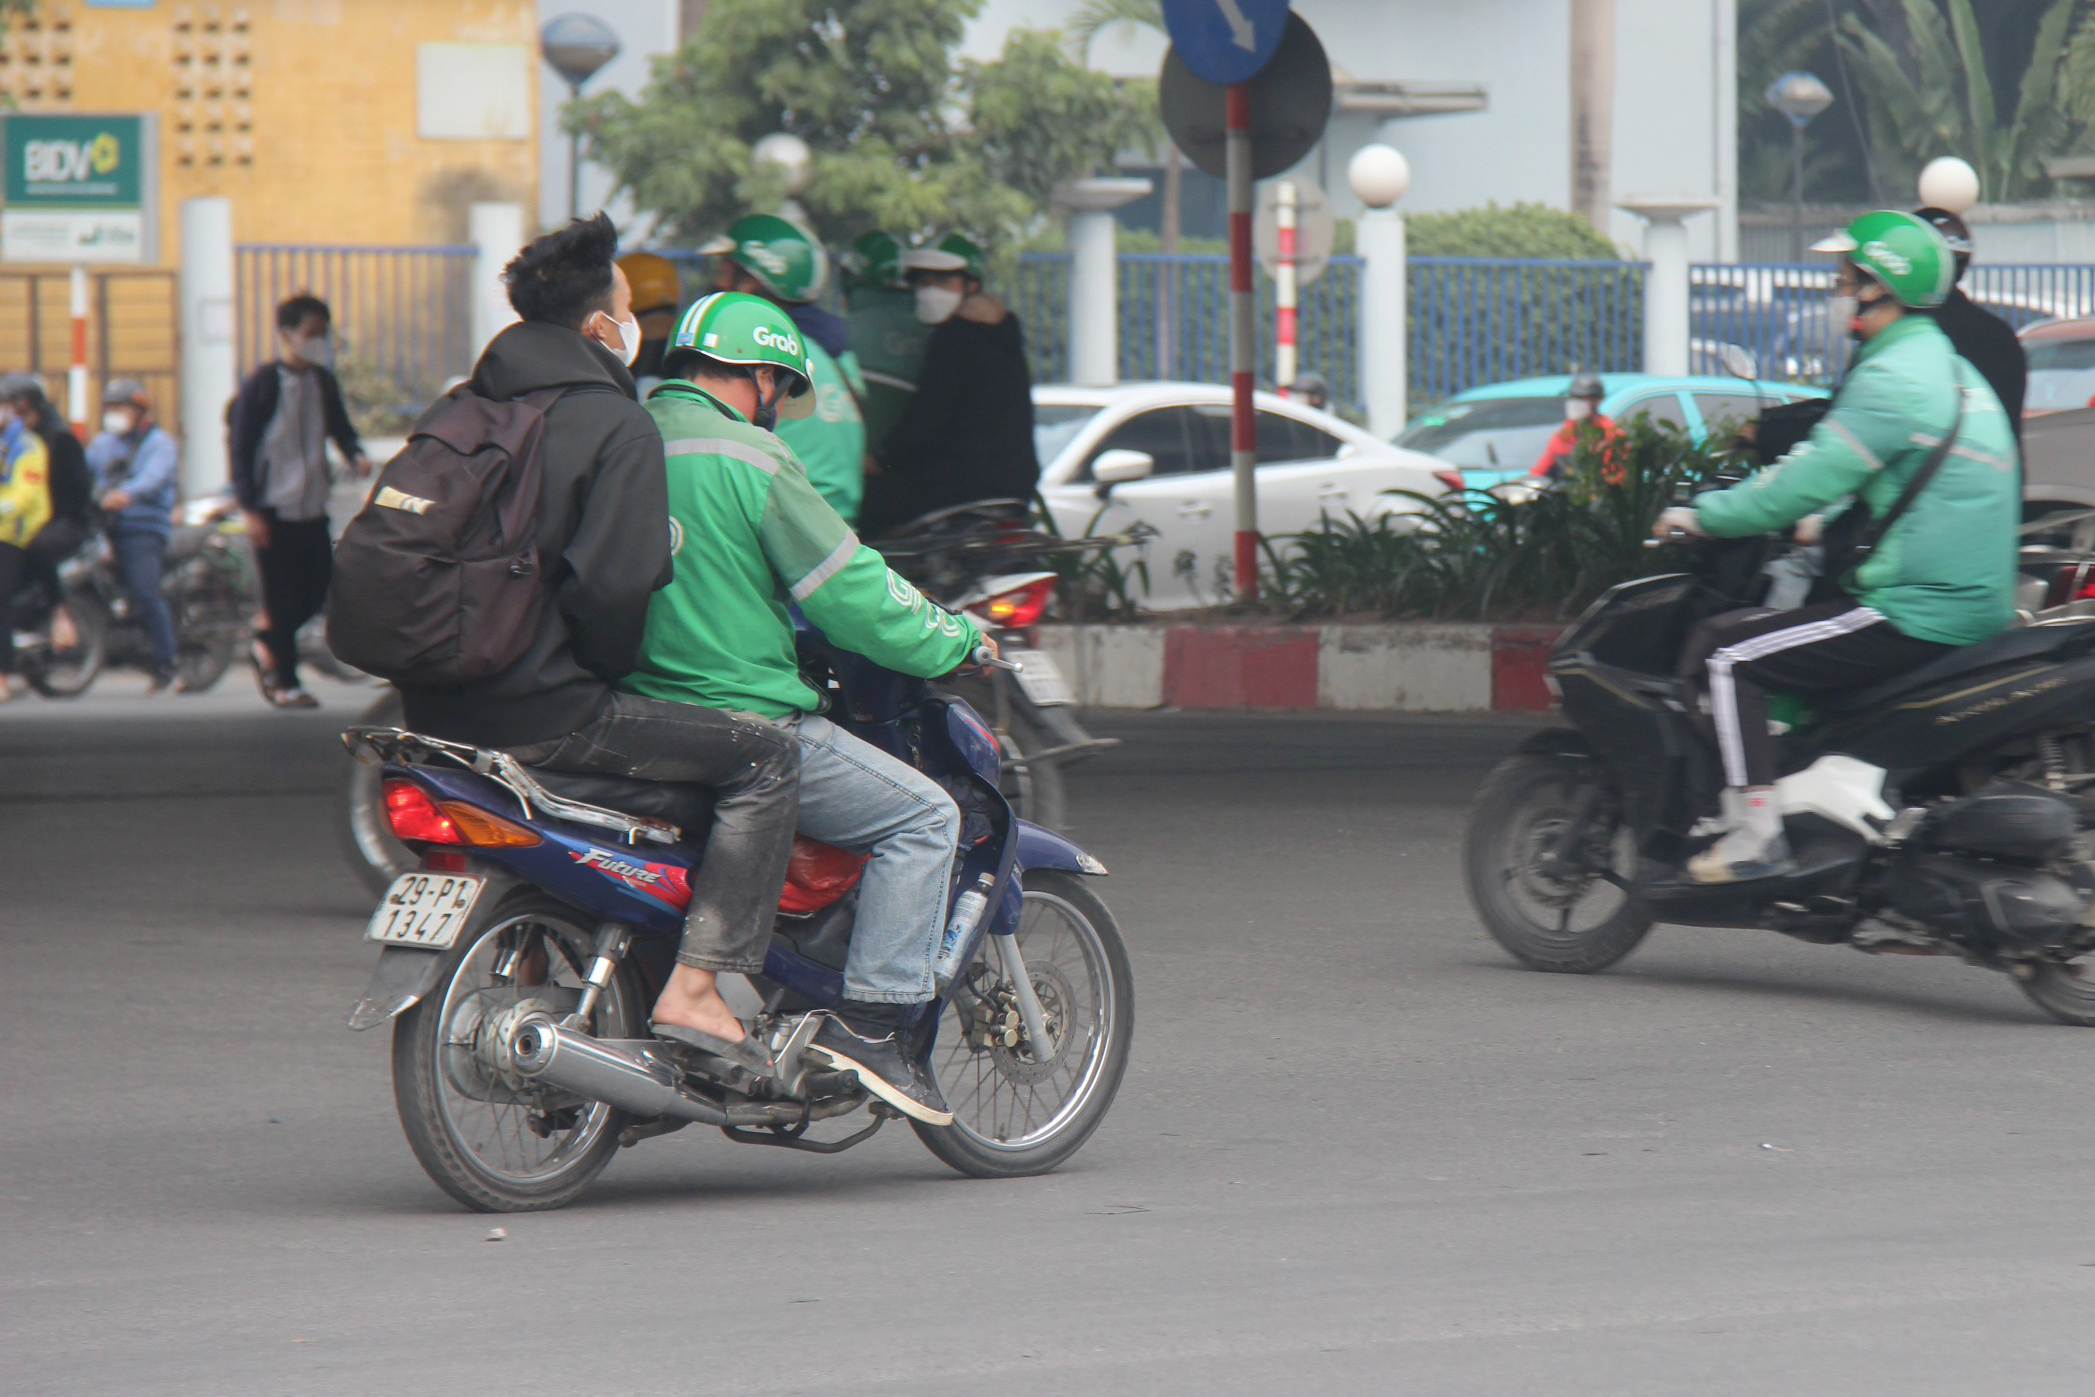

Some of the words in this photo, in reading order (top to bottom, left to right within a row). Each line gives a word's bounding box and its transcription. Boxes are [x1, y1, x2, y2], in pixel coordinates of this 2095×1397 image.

[752, 326, 798, 356] Grab
[391, 876, 468, 909] 29-P1
[383, 909, 454, 942] 1347
